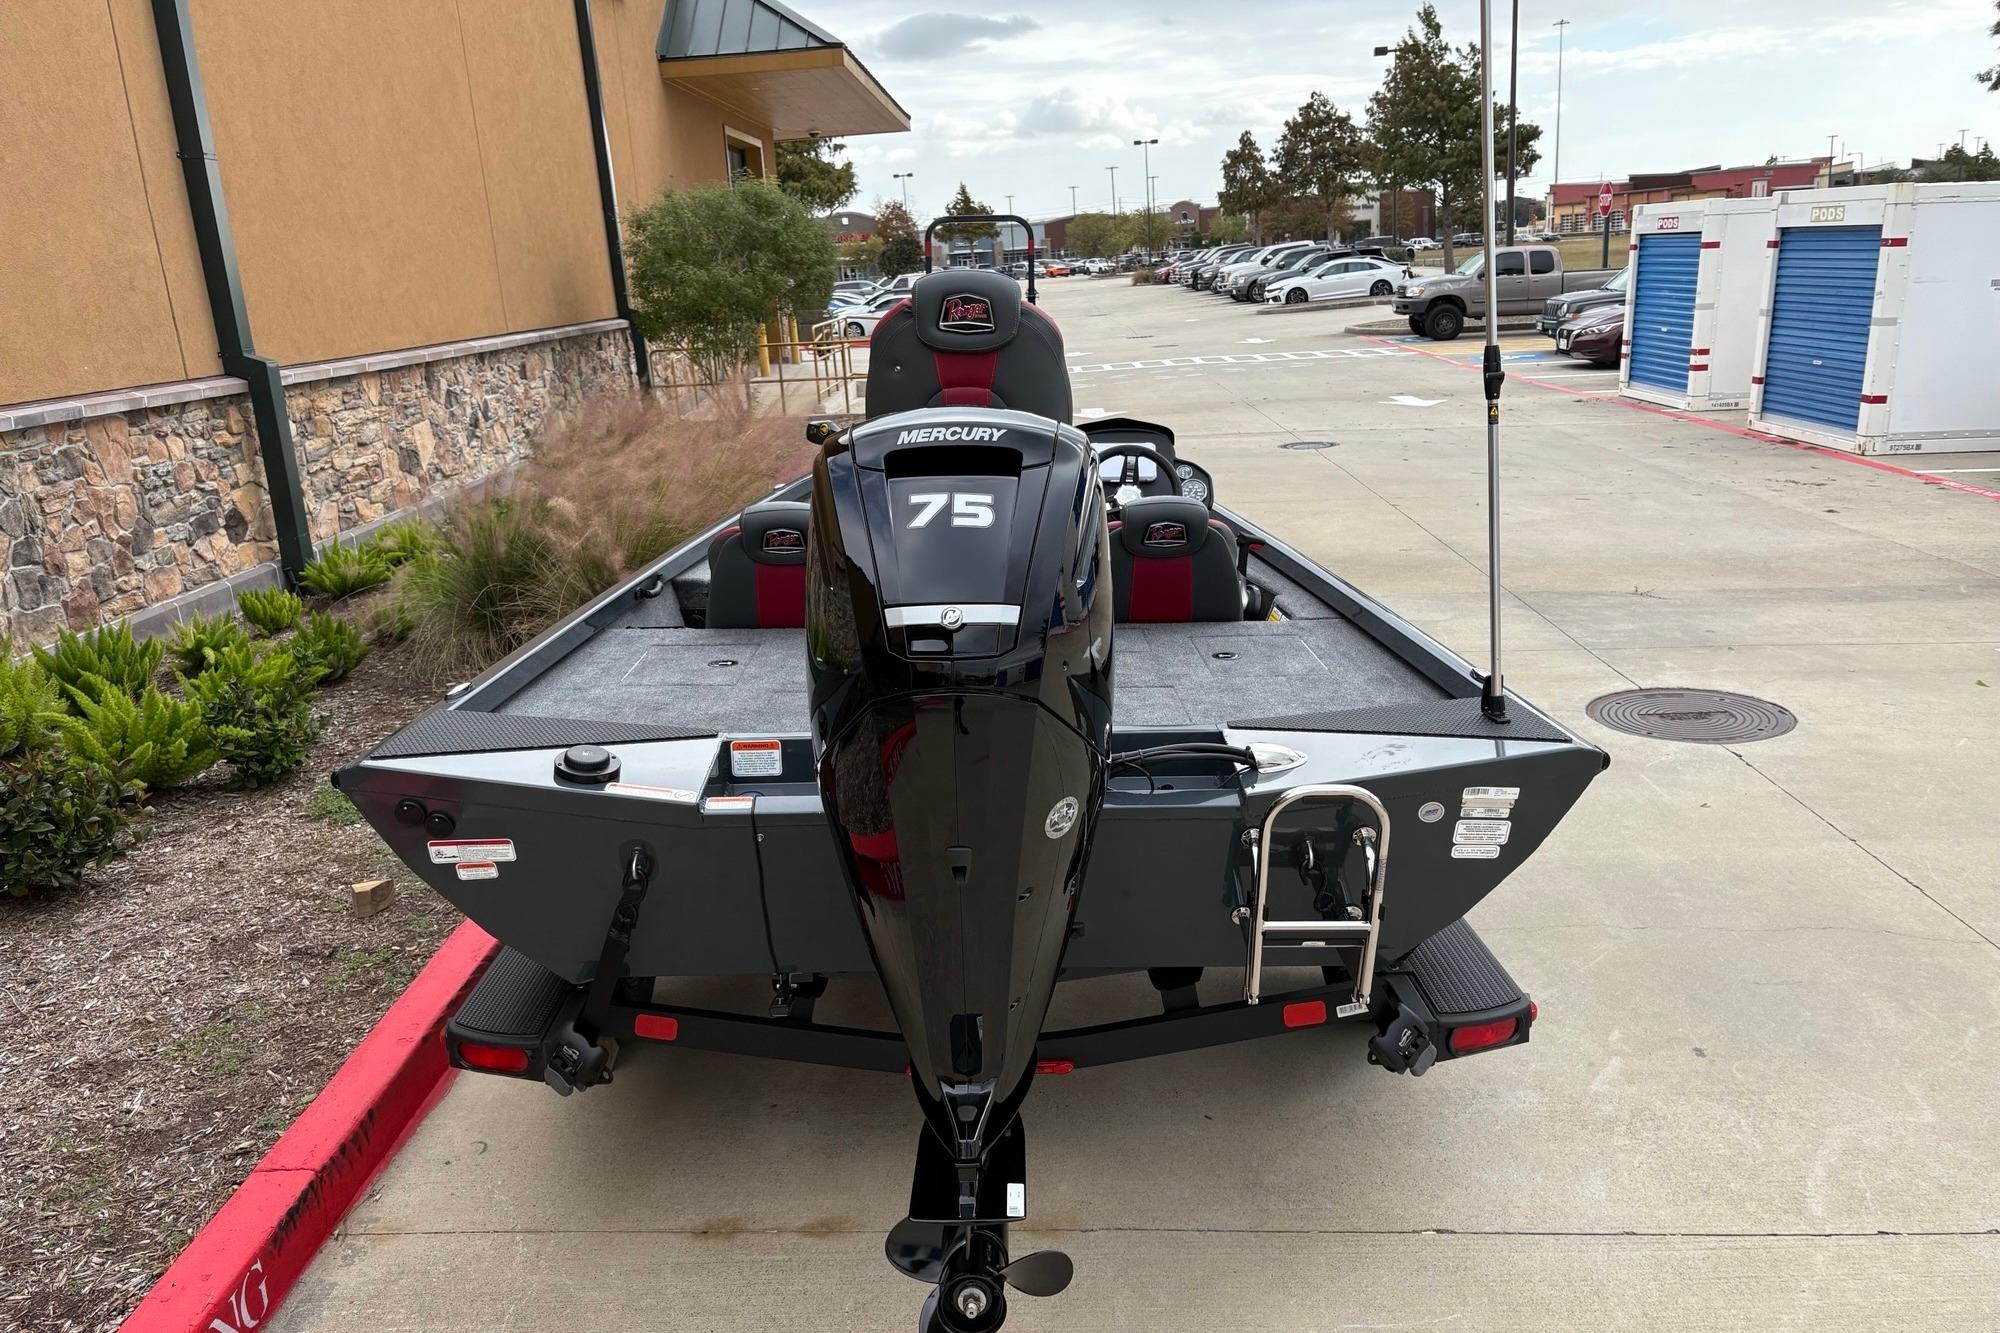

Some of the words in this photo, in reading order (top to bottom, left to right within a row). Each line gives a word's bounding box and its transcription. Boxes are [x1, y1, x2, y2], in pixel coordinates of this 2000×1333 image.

[1600, 193, 1612, 206] STOP
[1811, 207, 1844, 221] PODS
[1658, 218, 1678, 229] PODS
[897, 426, 1007, 445] MERCURY
[907, 493, 995, 528] 75
